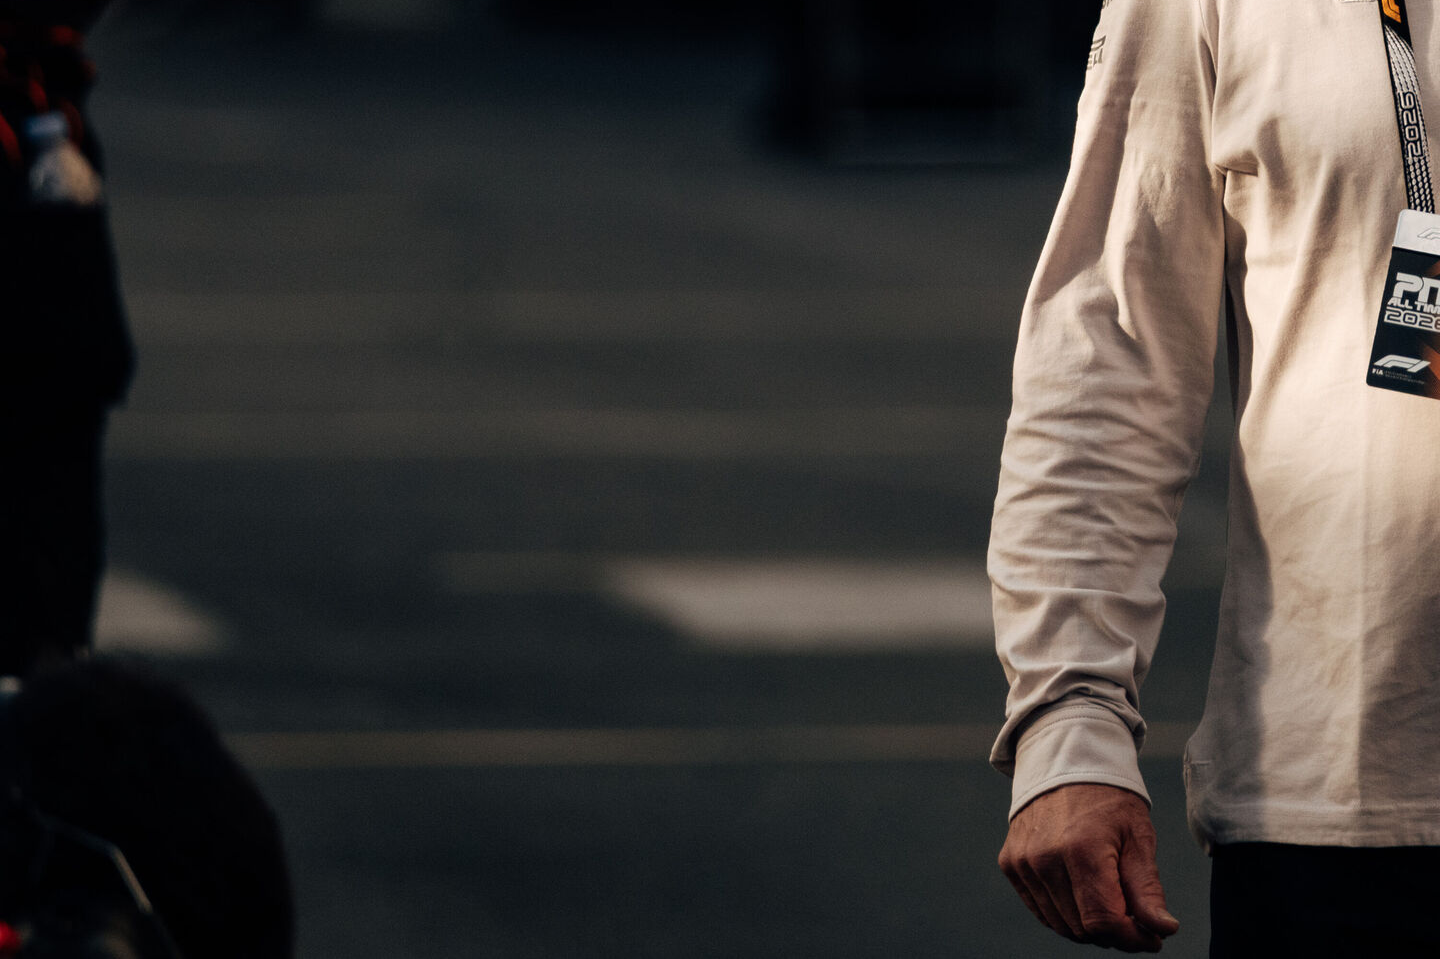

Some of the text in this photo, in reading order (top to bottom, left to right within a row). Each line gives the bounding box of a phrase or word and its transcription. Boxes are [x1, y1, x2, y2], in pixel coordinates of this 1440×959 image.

[1398, 91, 1423, 158] 2026
[1387, 296, 1414, 309] ALL
[1371, 367, 1384, 376] FIA
[1373, 354, 1431, 373] F1
